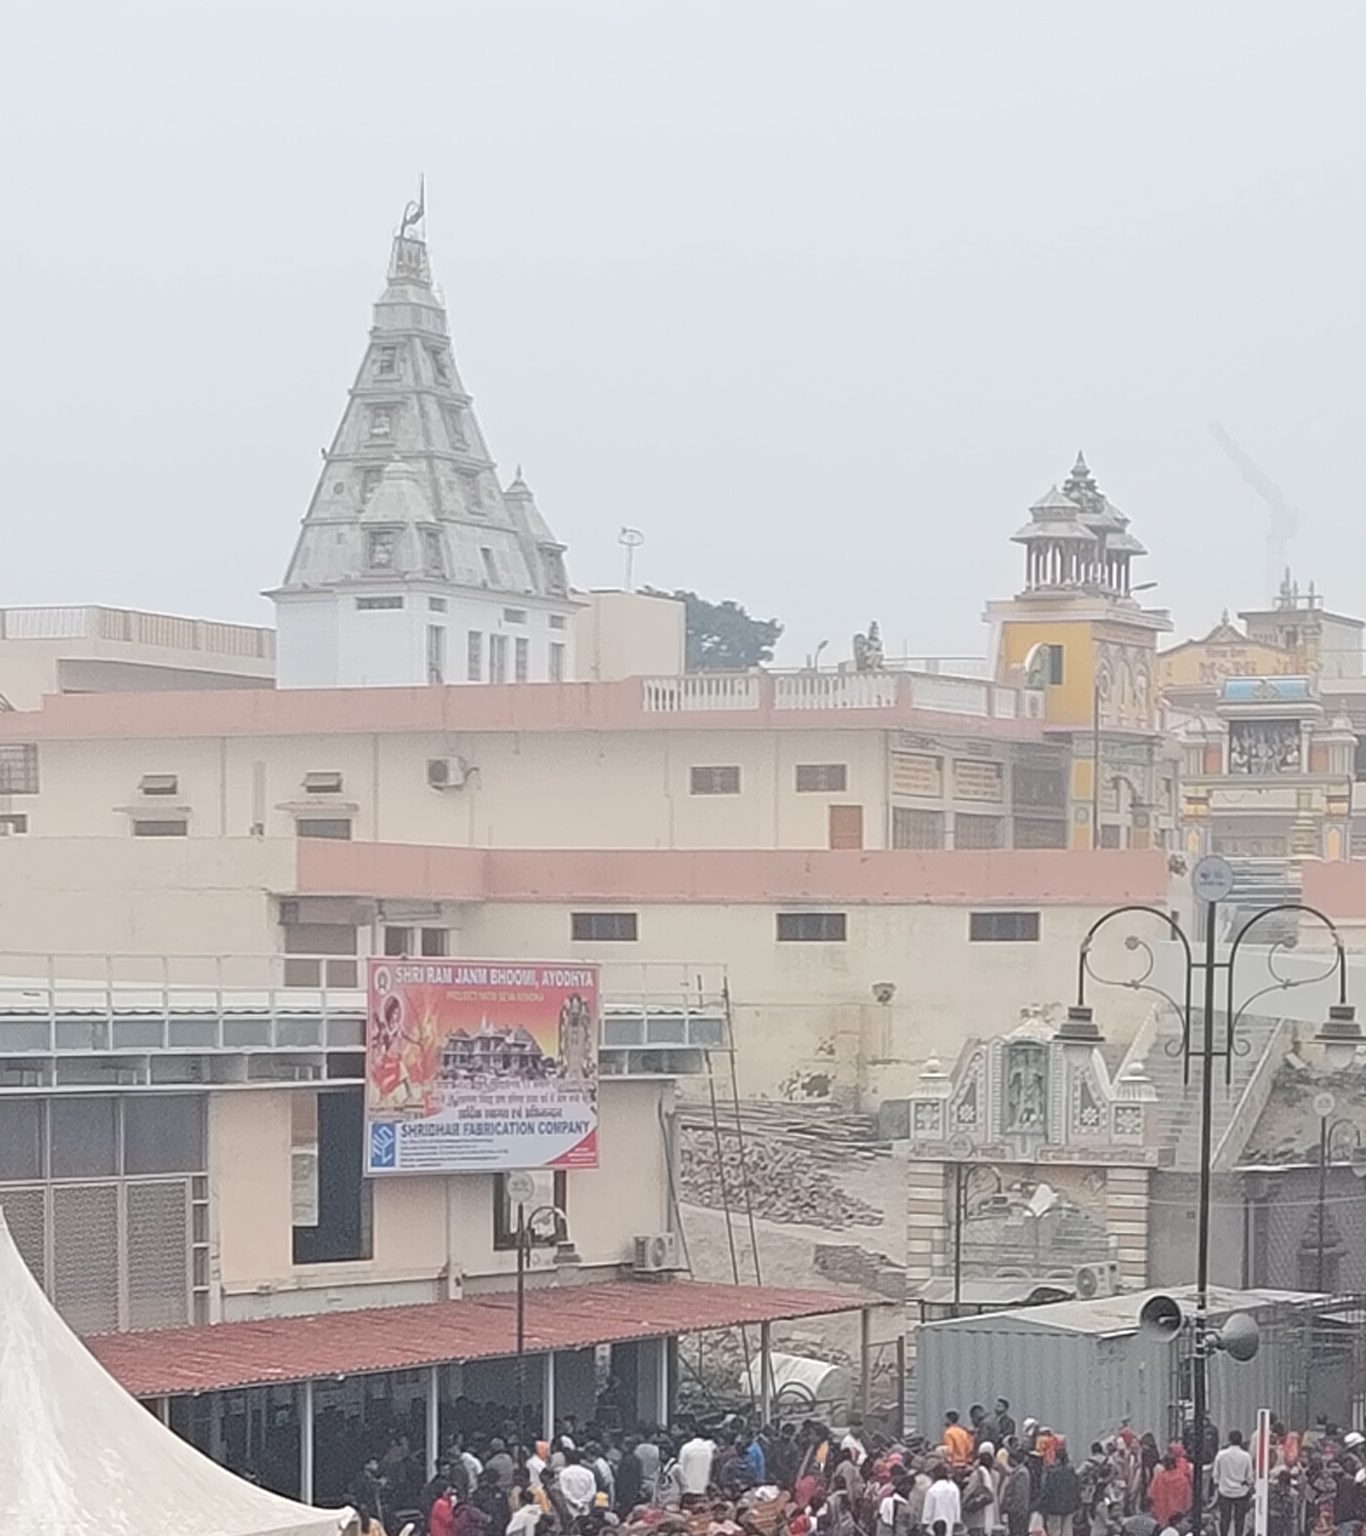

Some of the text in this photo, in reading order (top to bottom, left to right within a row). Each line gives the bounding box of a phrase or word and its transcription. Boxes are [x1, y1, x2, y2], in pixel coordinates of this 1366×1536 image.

[395, 967, 424, 984] SHRI
[426, 968, 452, 984] RAM
[455, 969, 486, 985] JANM
[541, 970, 594, 987] AYODHYA
[400, 1120, 590, 1138] SHRIDHAR FABRICATION COMPANY
